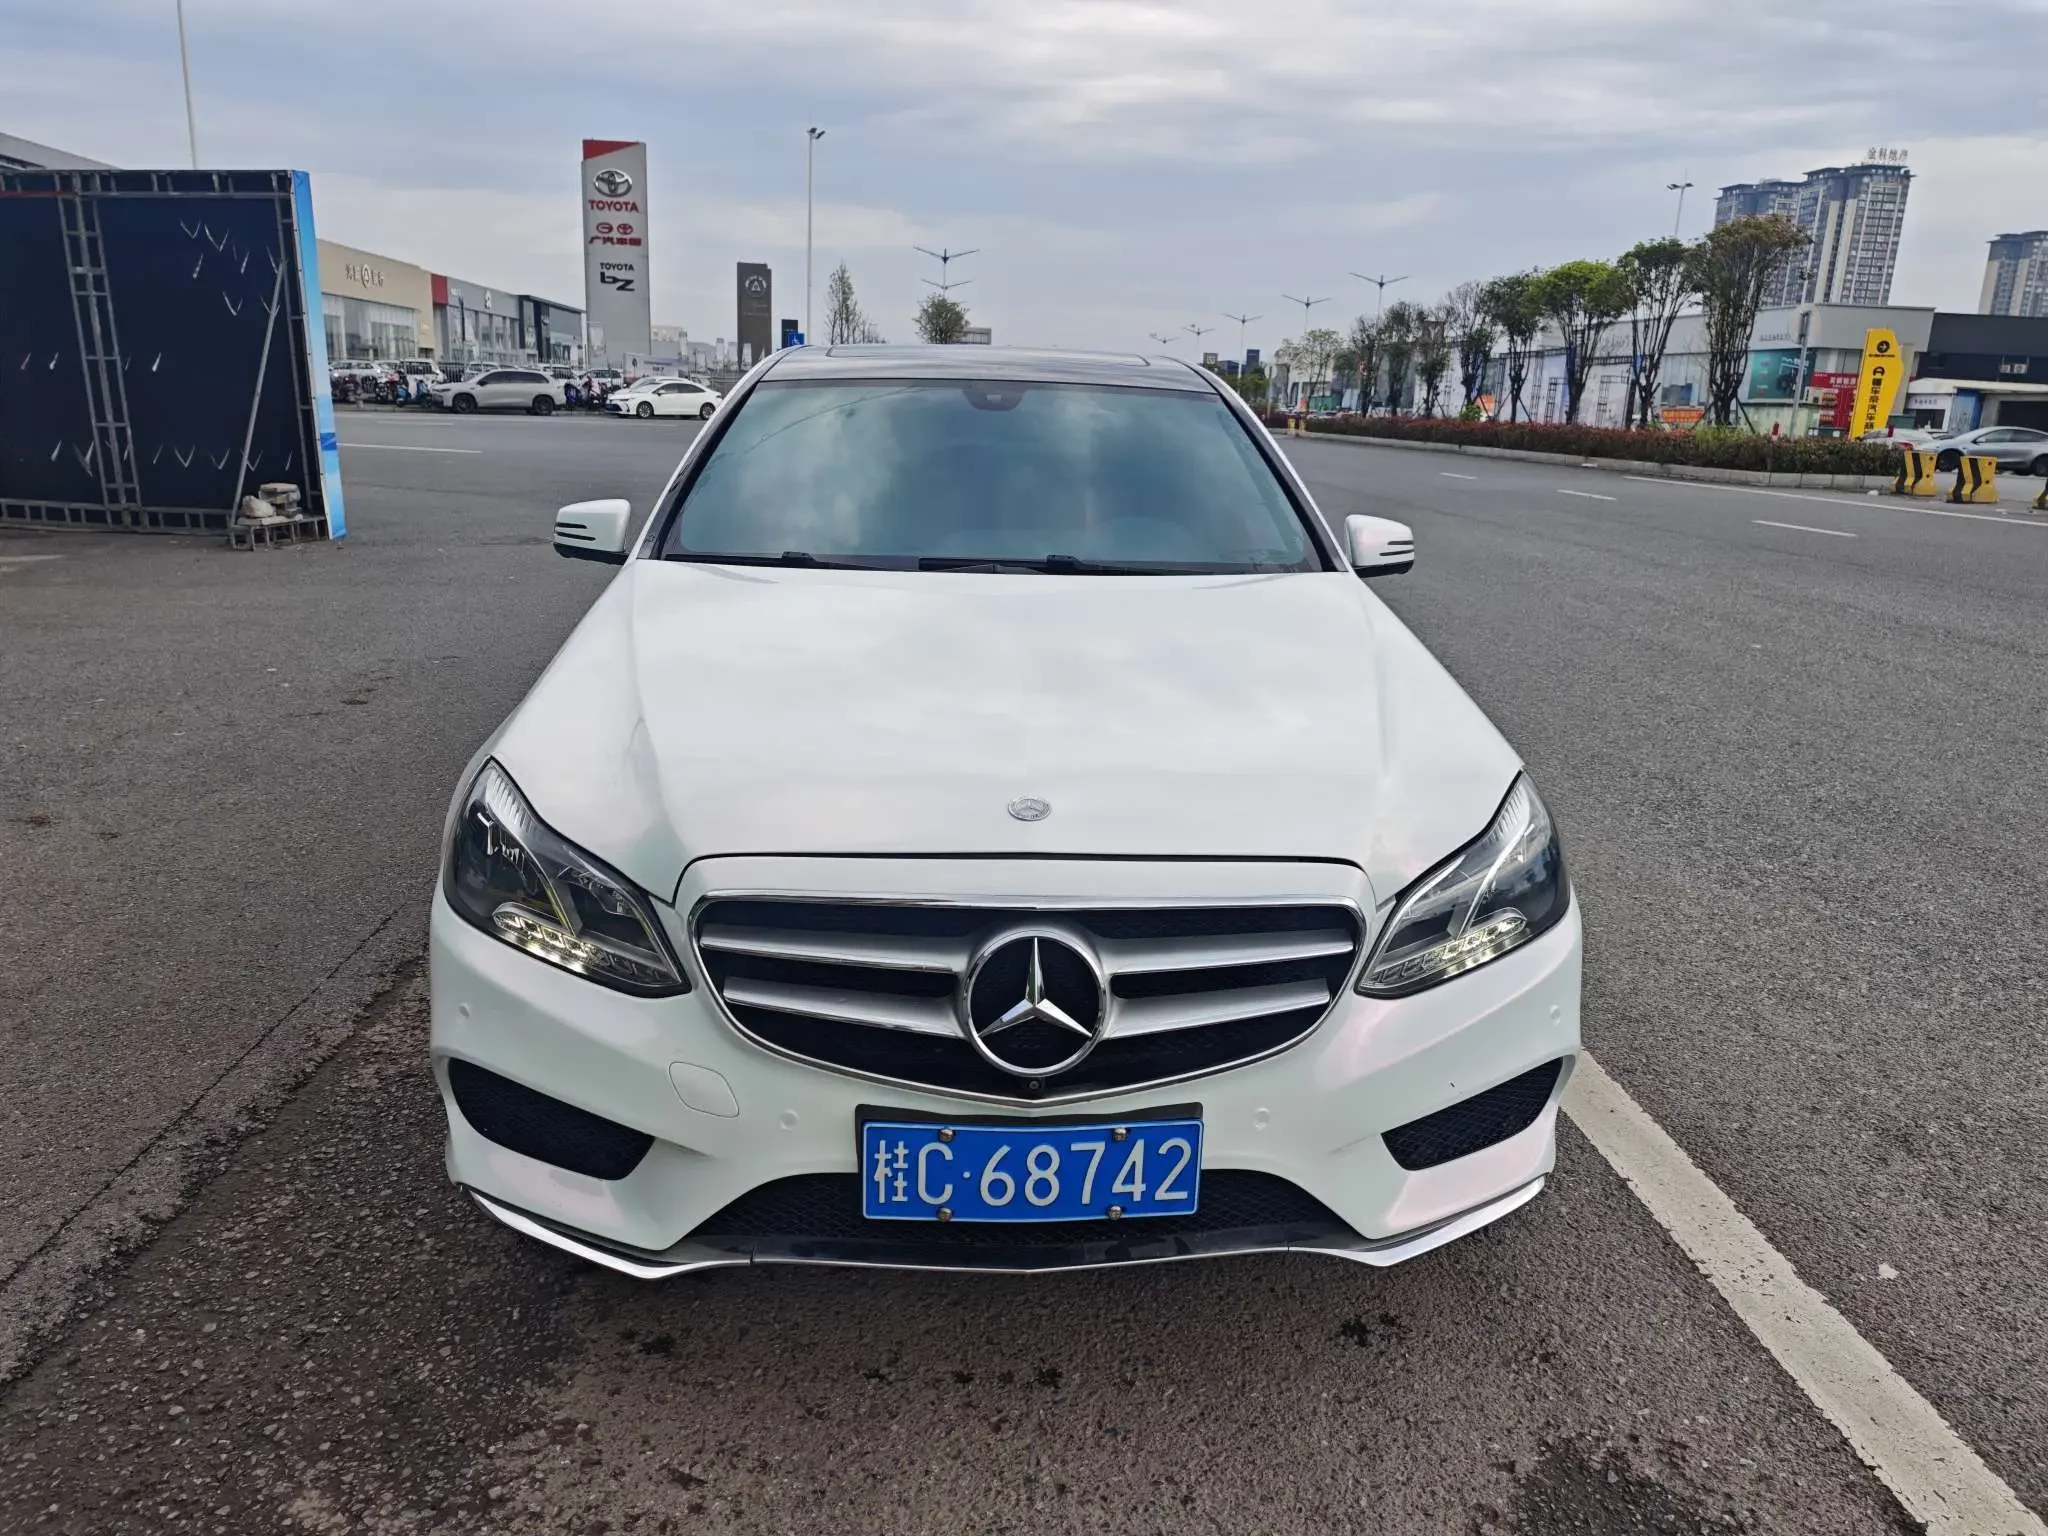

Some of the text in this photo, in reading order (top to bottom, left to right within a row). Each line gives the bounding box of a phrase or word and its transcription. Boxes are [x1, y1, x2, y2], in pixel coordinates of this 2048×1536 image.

[588, 199, 640, 213] TOYOTA
[600, 262, 635, 271] TOYOTA
[874, 1137, 1192, 1207] 桂C·68742
